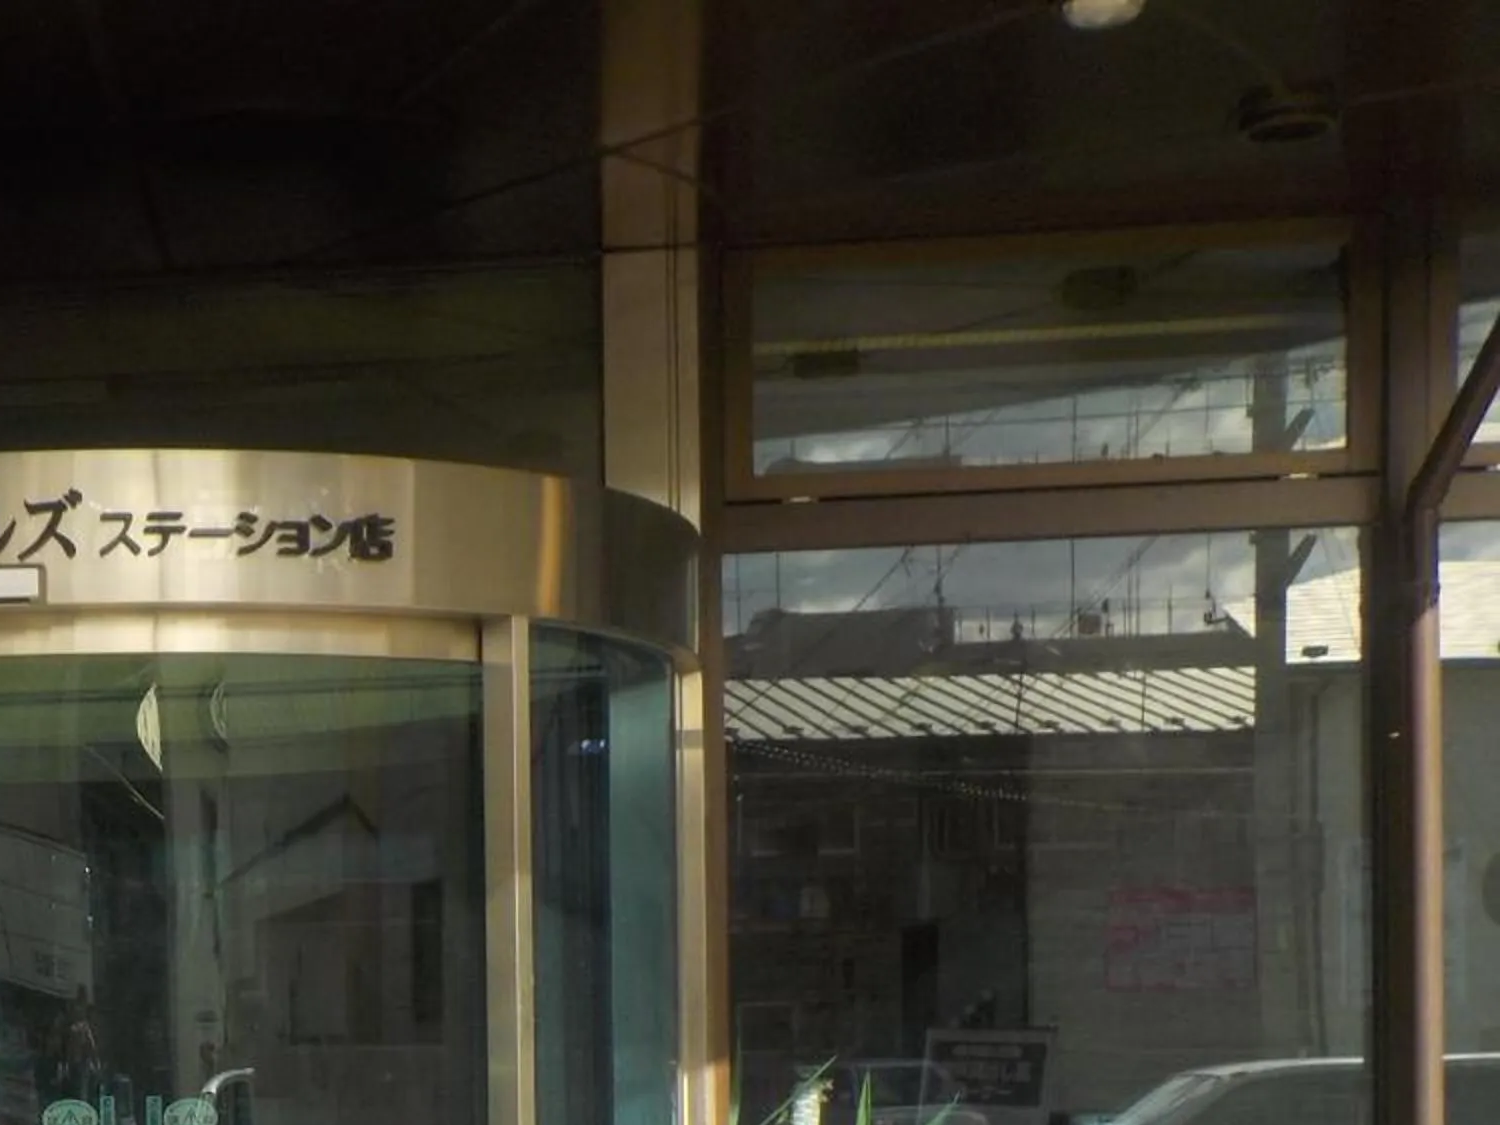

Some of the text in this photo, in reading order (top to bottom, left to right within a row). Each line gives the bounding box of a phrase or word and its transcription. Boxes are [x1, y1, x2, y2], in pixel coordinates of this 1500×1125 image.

[99, 511, 395, 561] ステーション店
